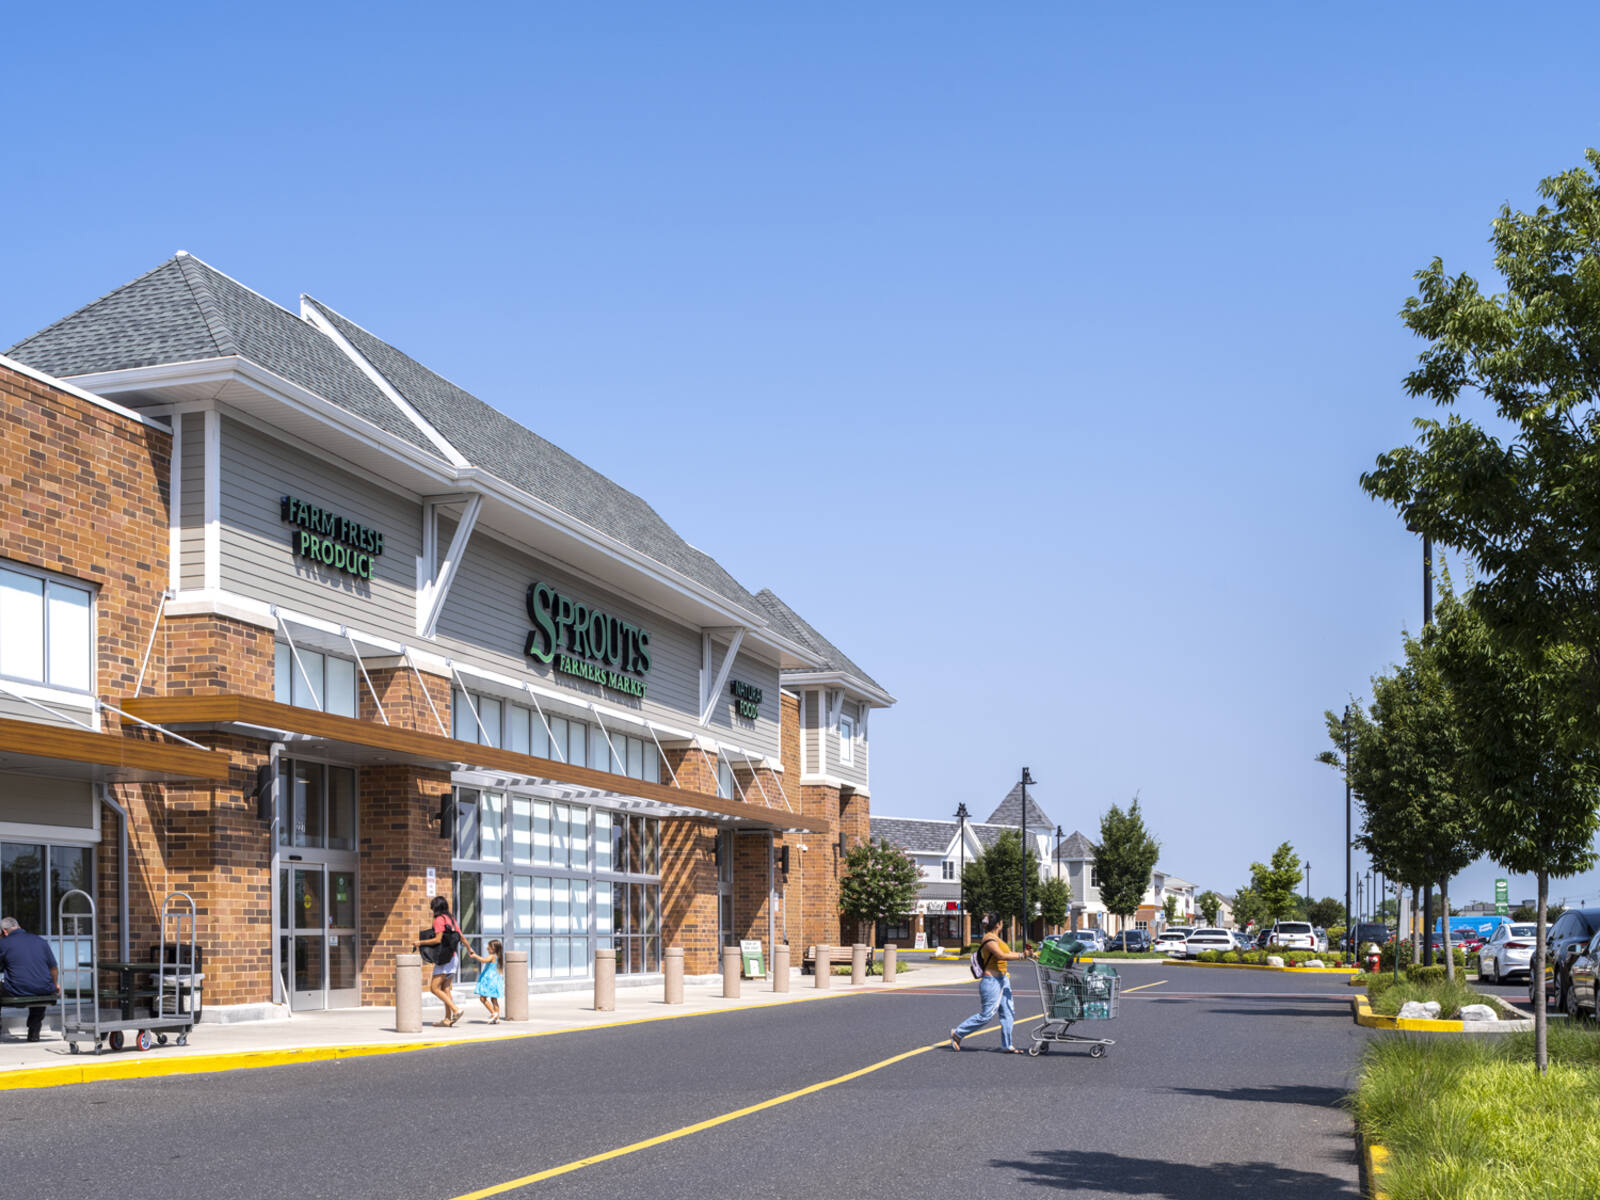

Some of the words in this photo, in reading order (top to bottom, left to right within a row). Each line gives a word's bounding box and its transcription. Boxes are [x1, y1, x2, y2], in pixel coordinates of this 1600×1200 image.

[288, 497, 336, 537] FARM
[341, 517, 384, 555] FRESH
[300, 531, 375, 580] PRODUCE
[530, 582, 652, 674] SPROUTS
[559, 654, 606, 685] FARMERS
[608, 672, 648, 698] MARKET
